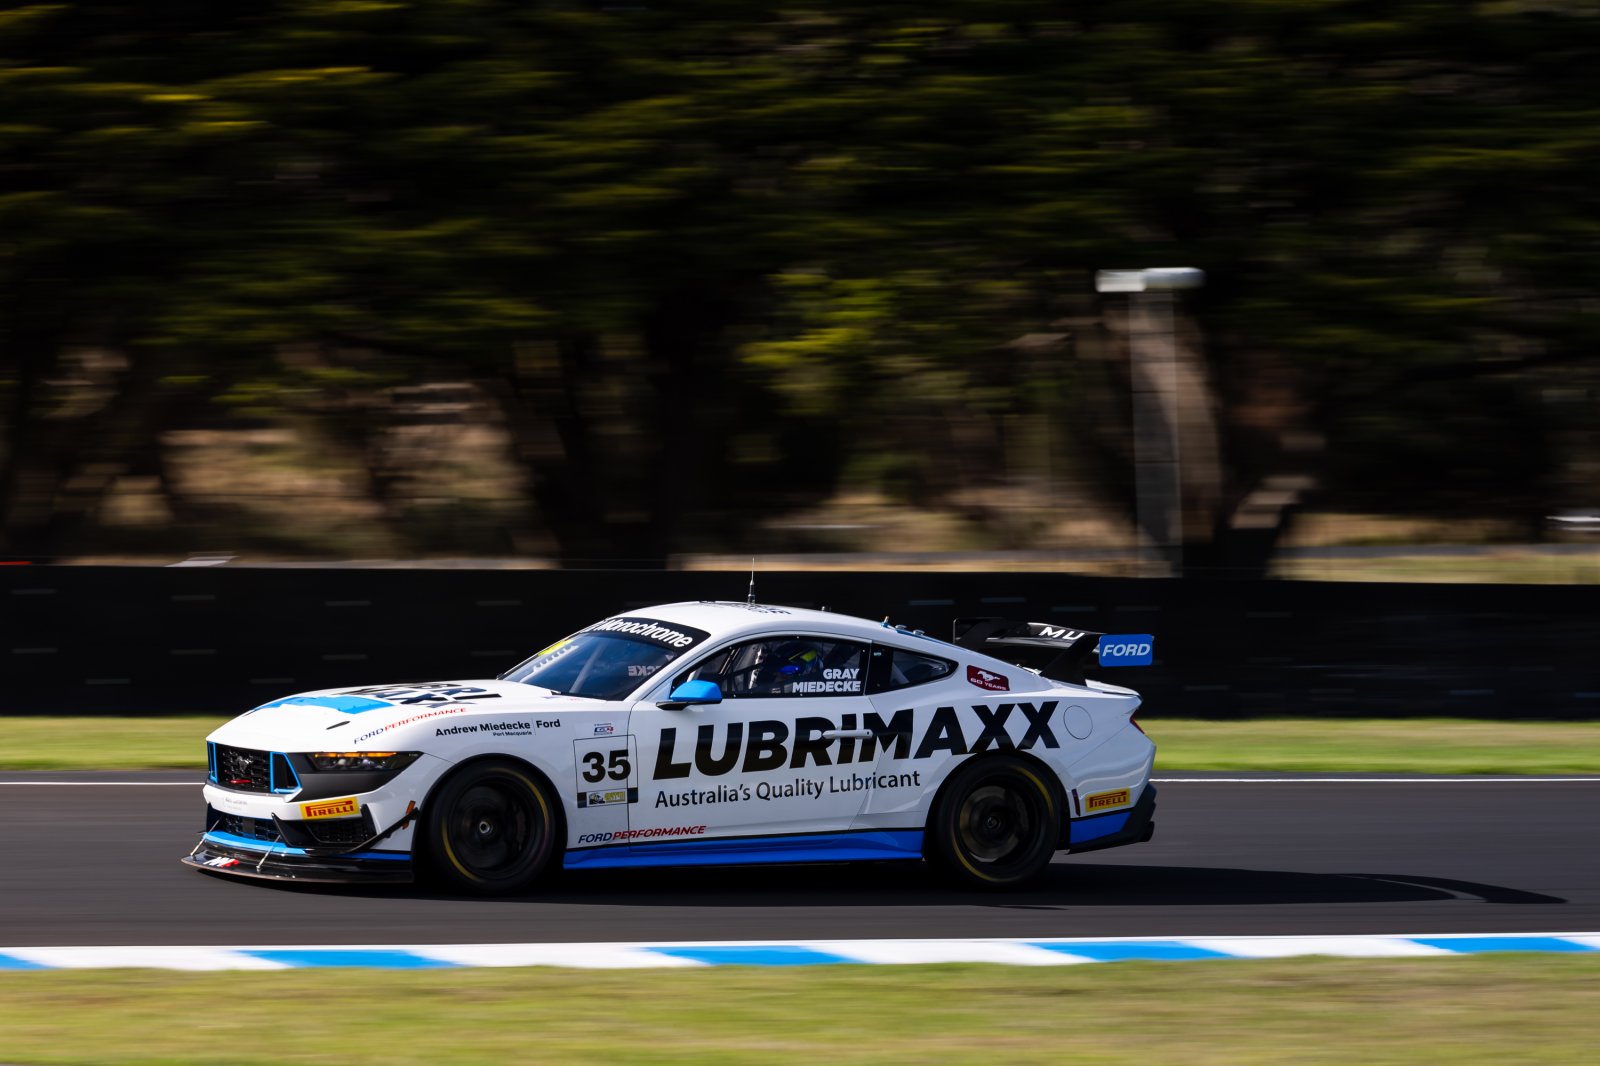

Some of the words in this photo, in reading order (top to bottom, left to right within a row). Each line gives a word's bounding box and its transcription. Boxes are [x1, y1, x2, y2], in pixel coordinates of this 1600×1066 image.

[1102, 643, 1151, 657] FORD
[823, 668, 860, 680] GRAY
[792, 680, 861, 693] MIEDECKE
[984, 681, 1007, 690] YEARS
[435, 724, 478, 737] Andrew
[480, 721, 531, 732] Miedecke
[536, 719, 561, 729] Ford
[653, 701, 1060, 780] LUBRIMAXX
[582, 749, 631, 783] 35
[655, 783, 751, 808] Australia's
[756, 778, 825, 801] Quality
[830, 771, 920, 793] Lubricant
[1089, 791, 1127, 808] PIRELLI
[305, 800, 354, 817] PIRELLI
